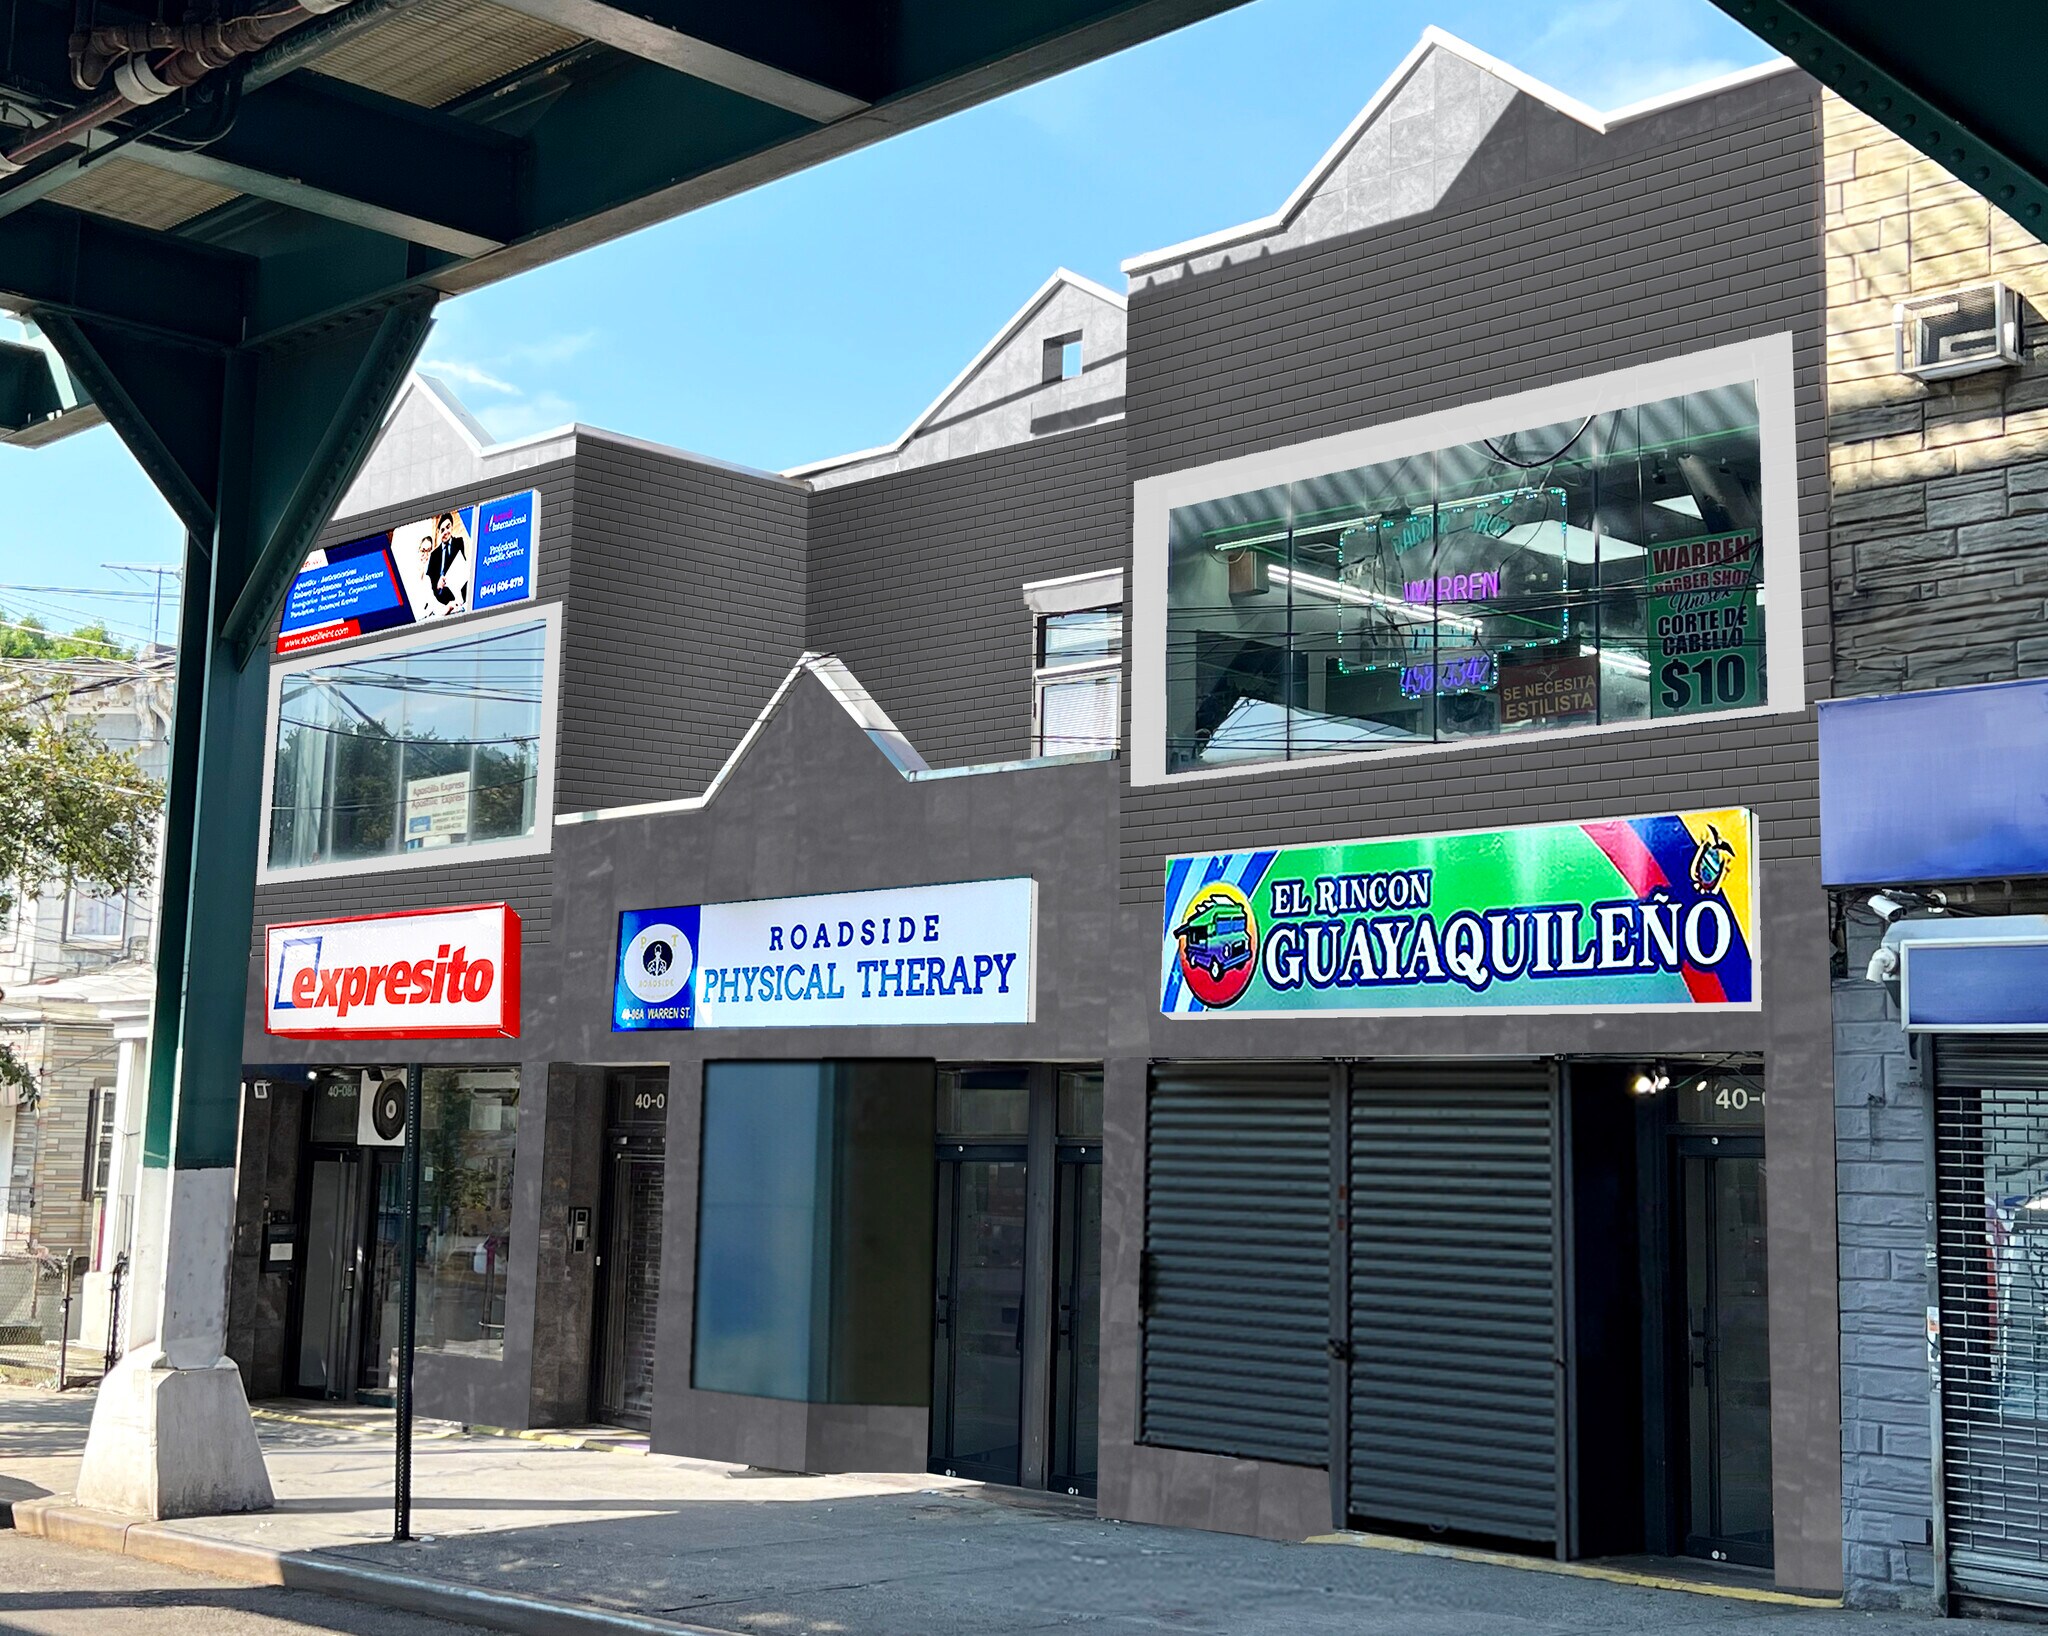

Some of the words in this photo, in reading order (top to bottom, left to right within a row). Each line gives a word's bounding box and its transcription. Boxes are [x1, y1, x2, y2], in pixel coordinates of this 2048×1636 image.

[1653, 535, 1751, 574] WARREN
[1403, 571, 1499, 606] WARREN
[1654, 573, 1710, 594] BARBER
[1657, 609, 1723, 636] CORTE
[1724, 604, 1748, 629] DE
[1662, 627, 1744, 656] CABELLO
[1503, 684, 1522, 701] SE
[1525, 675, 1596, 699] NECESITA
[1661, 655, 1746, 712] $10
[1505, 693, 1594, 720] ESTILISTA
[1273, 883, 1309, 916] EL
[1318, 871, 1431, 913] RINCON
[769, 914, 941, 952] ROADSIDE
[1265, 893, 1731, 986] GUAYAQUILEÑO
[291, 943, 495, 1017] expresito
[703, 962, 846, 1004] PHYSICAL
[857, 953, 1017, 999] THERAPY
[648, 1007, 679, 1019] WARREN
[680, 1007, 692, 1019] ST.
